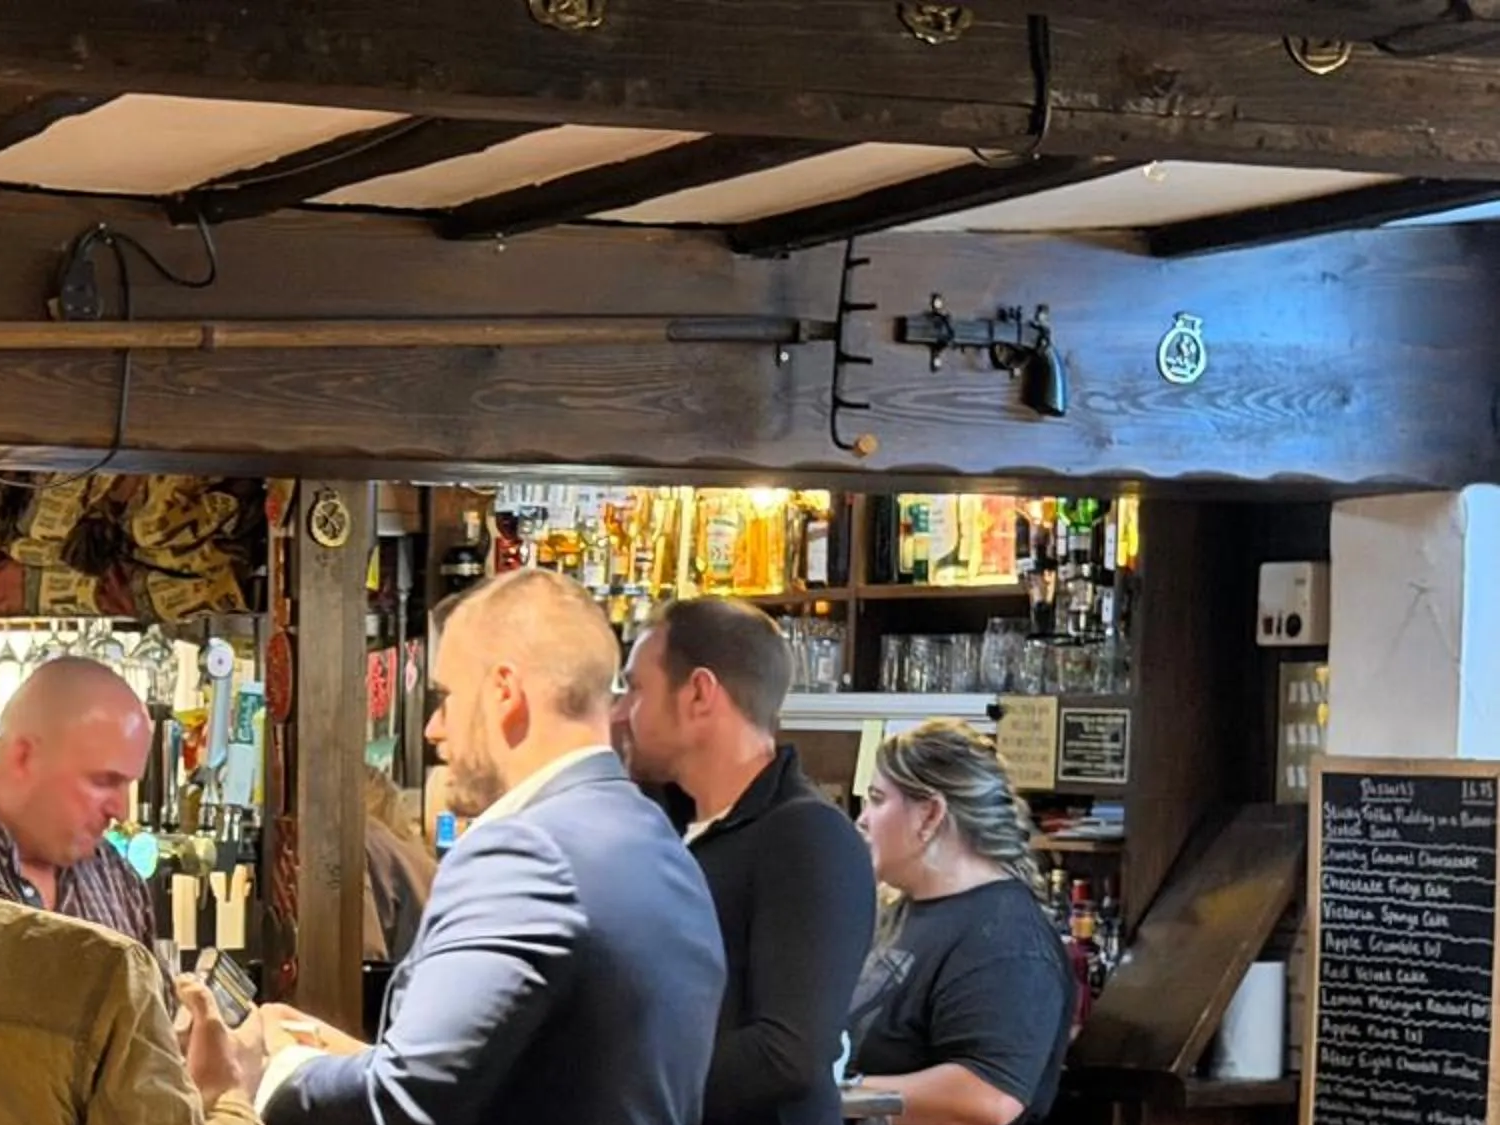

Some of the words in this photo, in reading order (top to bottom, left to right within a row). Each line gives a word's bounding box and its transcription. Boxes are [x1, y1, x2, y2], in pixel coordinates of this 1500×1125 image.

[1394, 807, 1434, 831] Pudding
[1371, 848, 1414, 865] Caramel
[1418, 850, 1479, 869] Cheesecake
[1323, 873, 1384, 893] Chocolate
[1388, 878, 1421, 900] Fudge
[1424, 882, 1451, 898] Cake
[1323, 901, 1375, 920] Victoria
[1381, 905, 1419, 930] Sponge
[1422, 910, 1450, 927] Cake
[1325, 931, 1362, 955] Apple
[1368, 934, 1421, 955] Crumble
[1323, 962, 1349, 979] Red
[1355, 966, 1393, 981] Velvet
[1396, 969, 1429, 983] Cake
[1322, 988, 1363, 1007] Lemon
[1367, 994, 1423, 1017] Meringue
[1322, 1017, 1361, 1040] Apple
[1321, 1047, 1355, 1067] After
[1358, 1051, 1393, 1075] Eight
